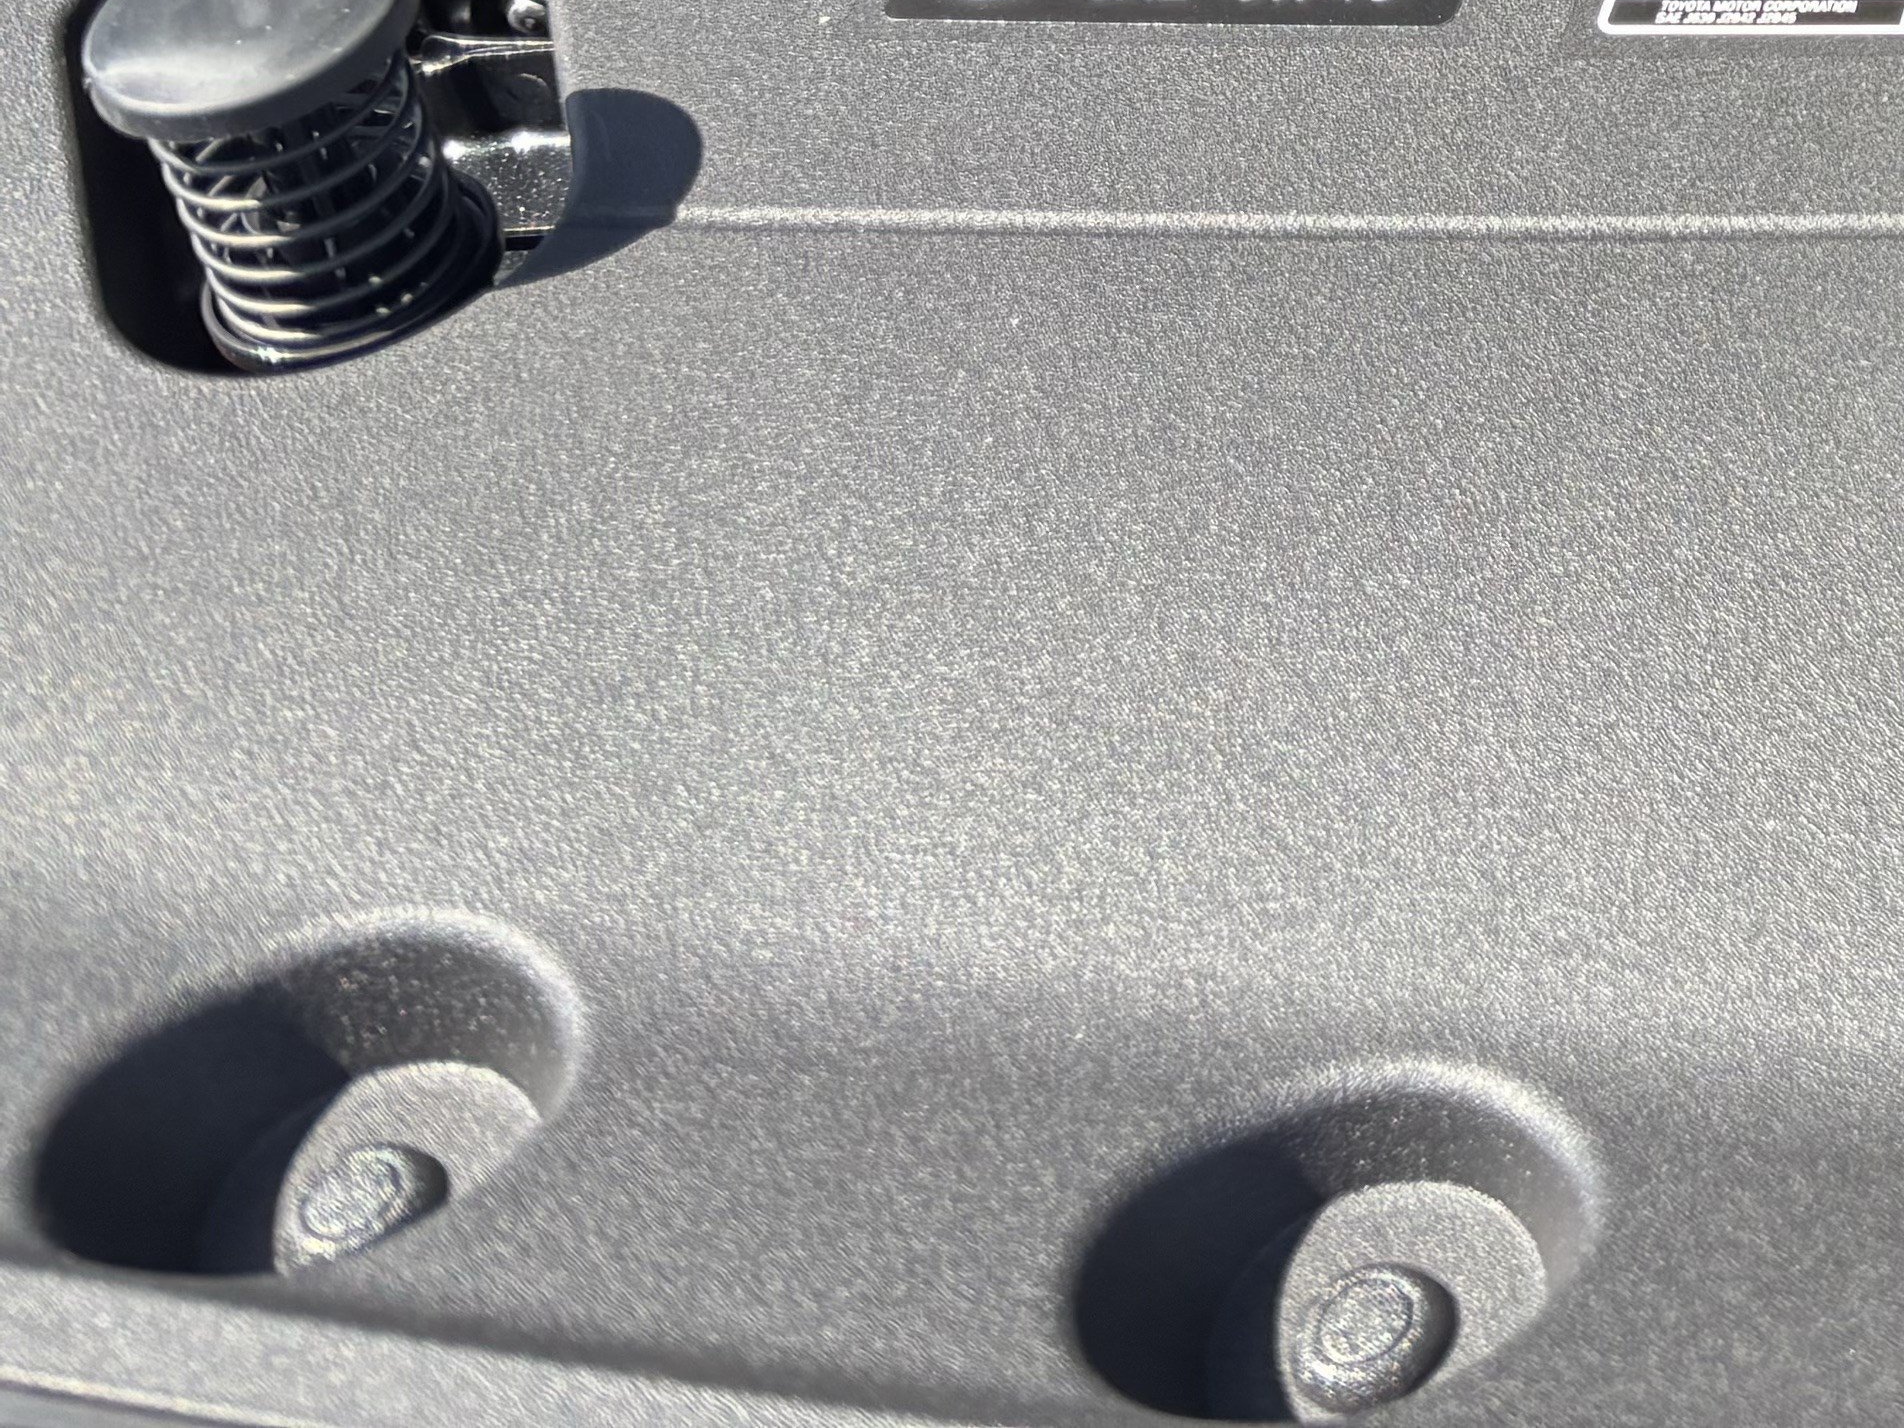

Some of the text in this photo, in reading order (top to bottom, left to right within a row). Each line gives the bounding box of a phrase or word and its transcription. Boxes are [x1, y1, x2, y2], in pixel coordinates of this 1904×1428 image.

[1661, 0, 1858, 13] TOYOTA MOTOR CORPORATION
